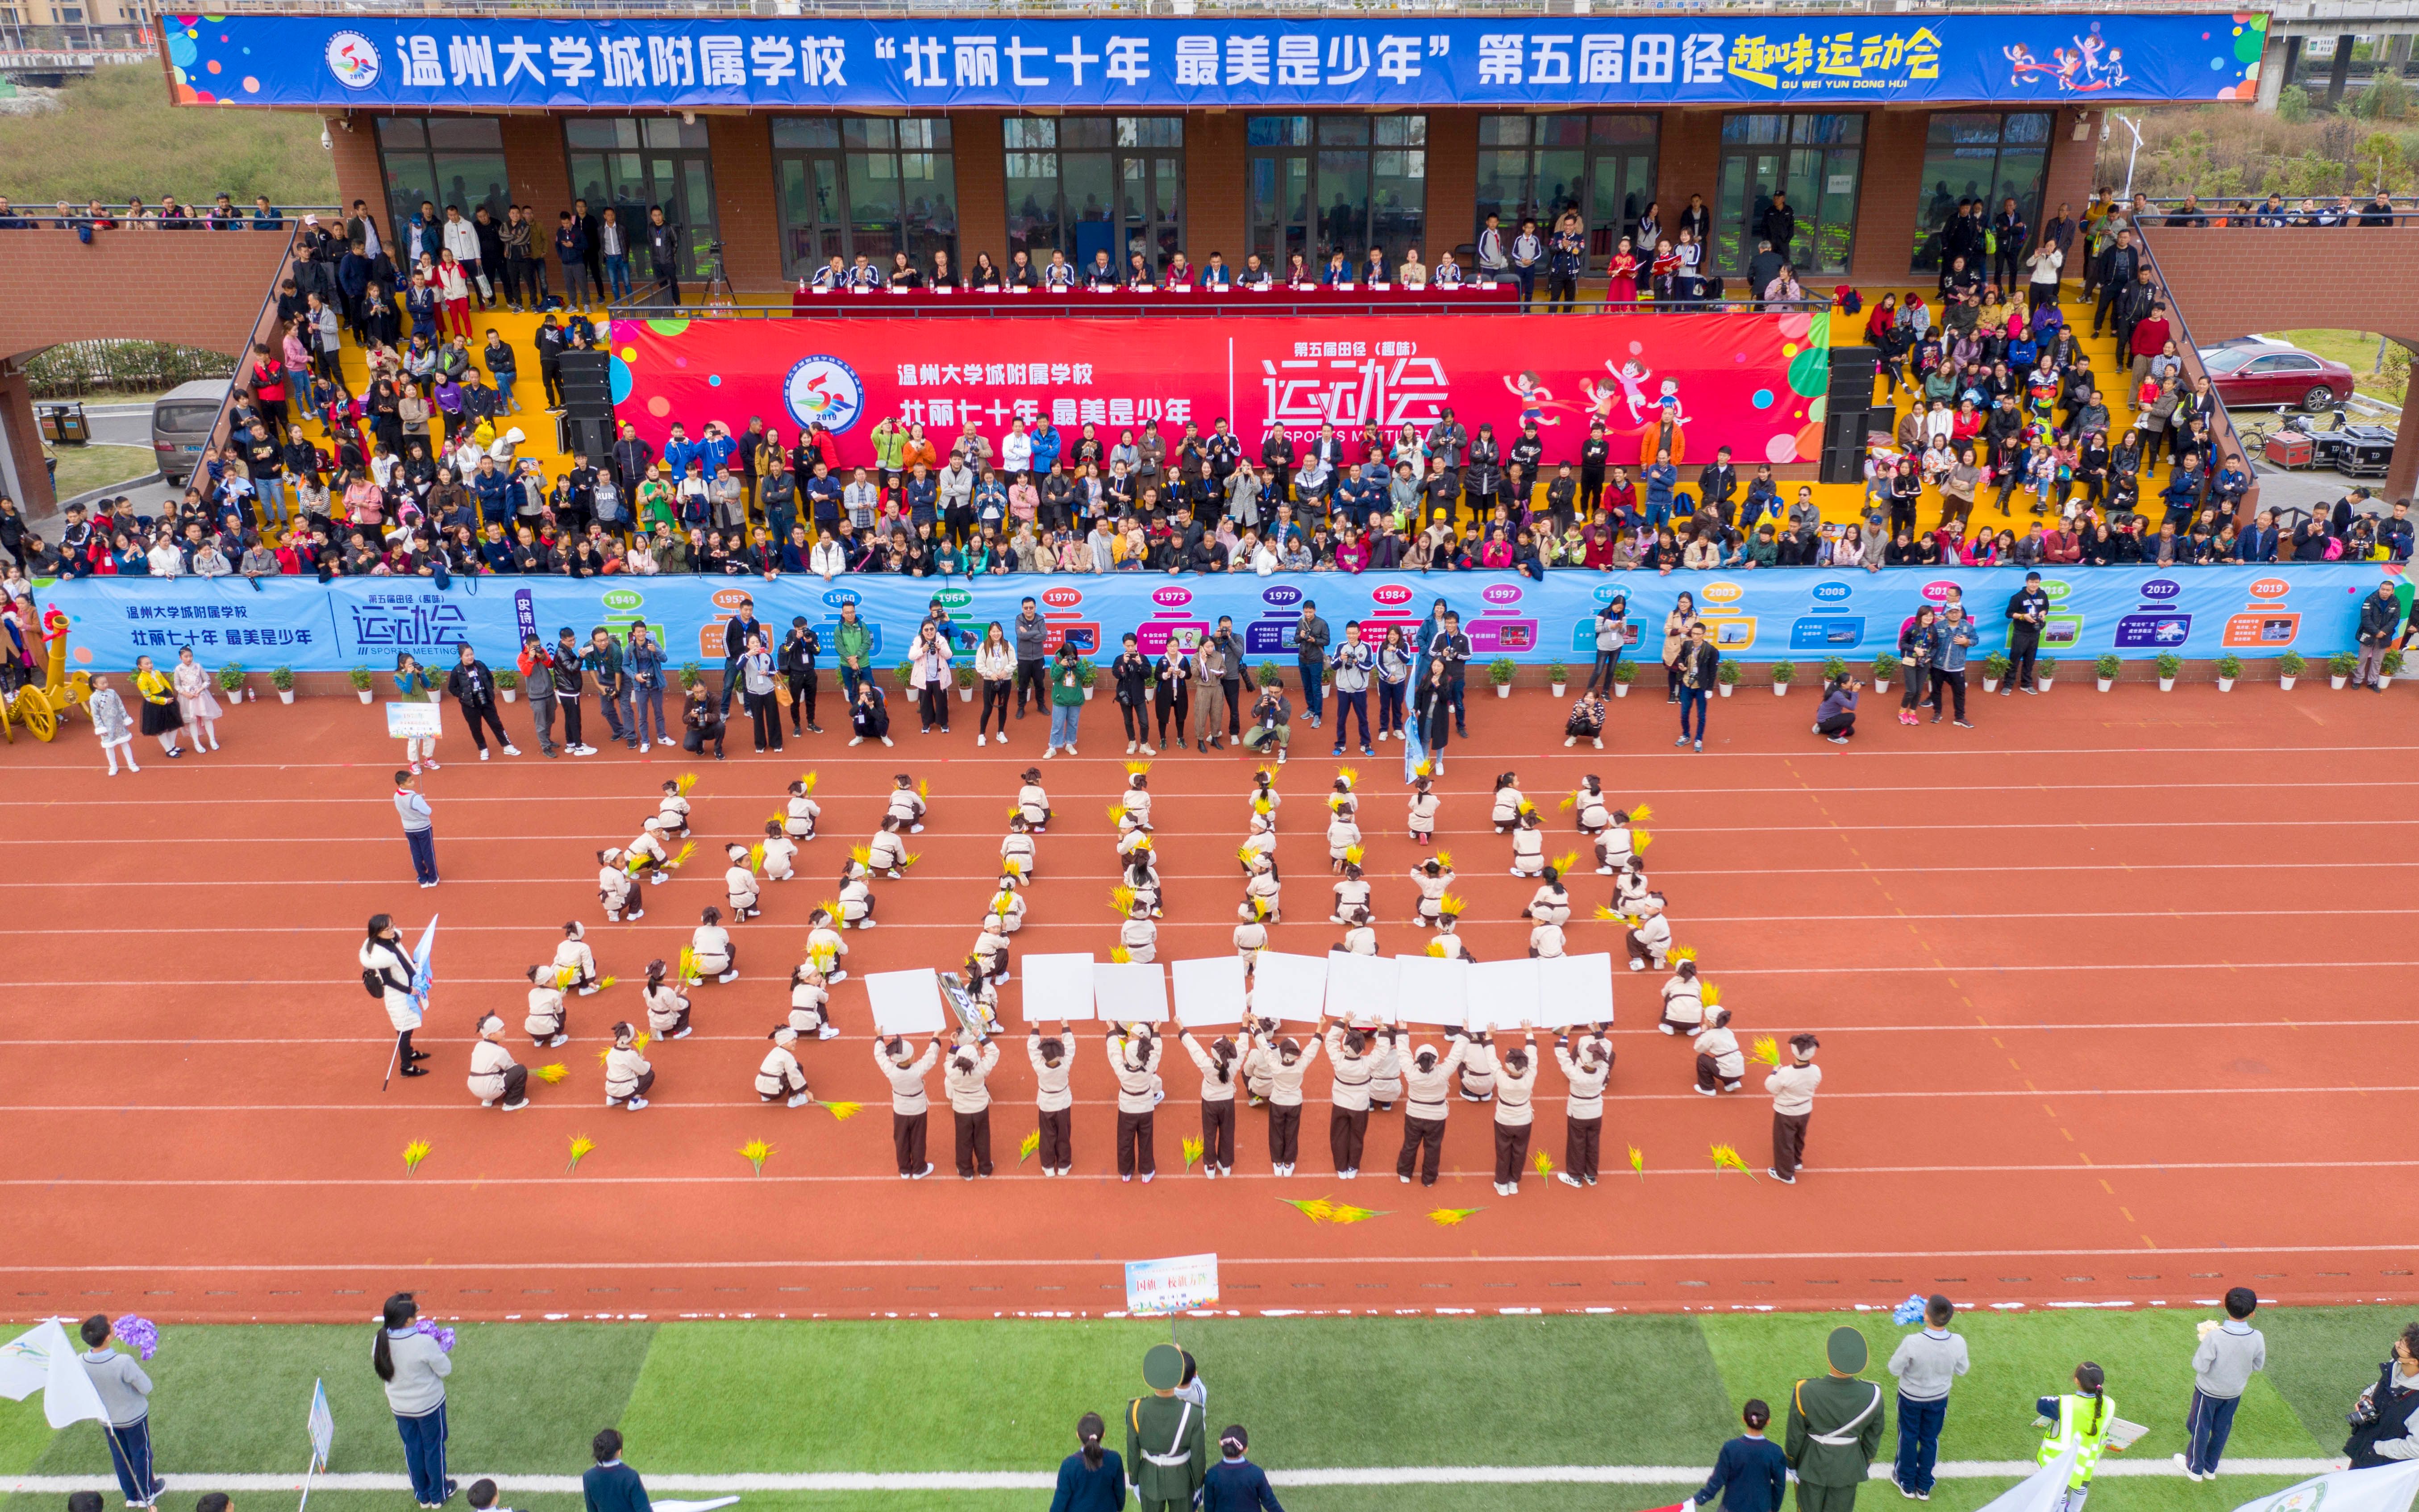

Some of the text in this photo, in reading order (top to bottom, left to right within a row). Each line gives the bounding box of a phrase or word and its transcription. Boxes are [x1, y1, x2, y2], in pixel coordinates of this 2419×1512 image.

[396, 27, 1942, 90] 温州大学城附属学校 “壮丽七十年 最美是少年” 第五届田径 趣味运动会
[1294, 341, 1417, 357] 第五届田径（趣味）
[898, 363, 1093, 386] 温州大学城附属学校
[1262, 358, 1449, 426] 运动会
[900, 398, 1191, 426] 壮丽七十年 最美是少年
[1599, 589, 1626, 597] 1999
[1709, 588, 1736, 596] 2003
[1928, 587, 1948, 595] 201
[2147, 586, 2173, 594] 2017
[2256, 584, 2283, 593] 2019
[1049, 593, 1075, 601] 1970
[1159, 592, 1186, 600] 1973
[1269, 591, 1295, 600] 1979
[1379, 591, 1406, 599] 1984
[1489, 590, 1516, 598] 1997
[369, 595, 445, 604] 第五届田径（趣味）
[610, 596, 636, 604] 1949
[720, 595, 745, 603] 1953
[829, 595, 855, 603] 1960
[126, 606, 248, 619] 温州大学城附属学校
[518, 599, 535, 637] 史诗70
[351, 605, 468, 645] 运动会
[131, 629, 312, 646] 壮丽七十年 最美是少年
